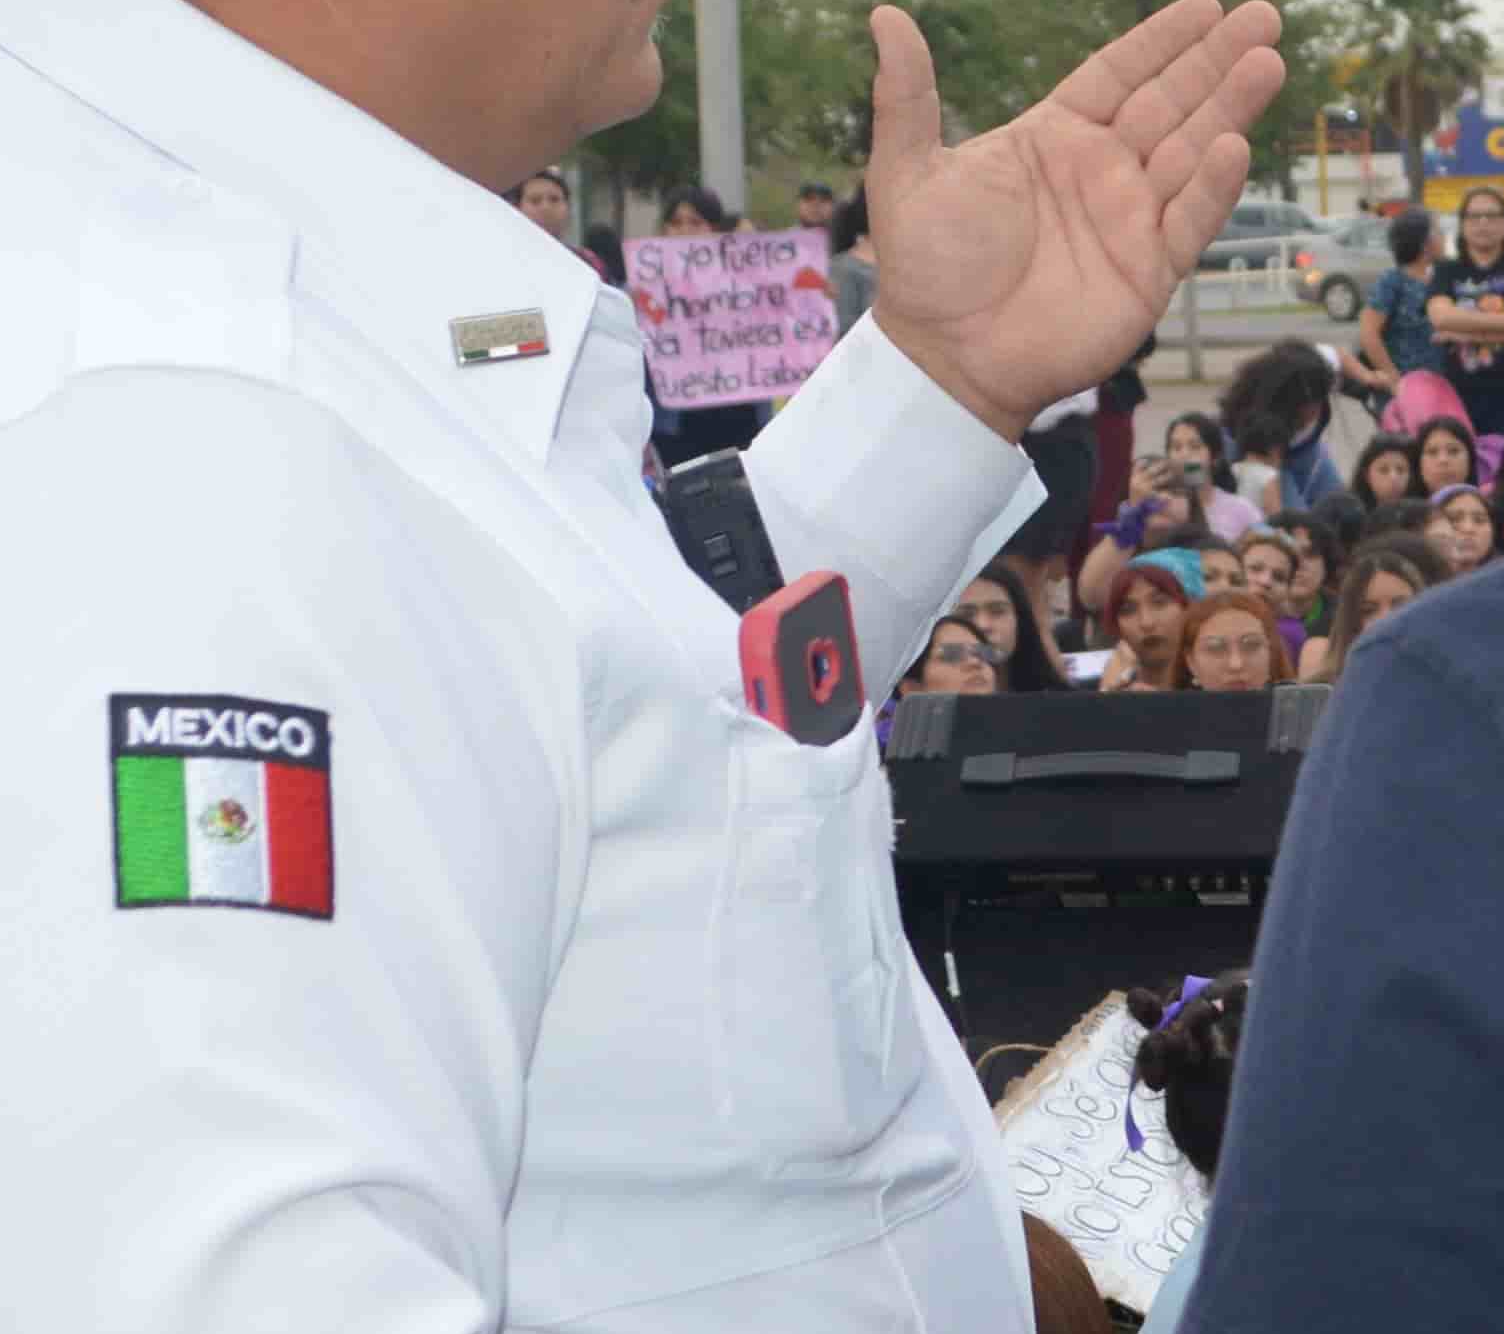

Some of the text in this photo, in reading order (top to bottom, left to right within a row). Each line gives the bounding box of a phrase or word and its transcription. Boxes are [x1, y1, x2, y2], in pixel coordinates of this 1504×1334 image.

[719, 235, 798, 272] fuera
[665, 278, 786, 317] hombre
[126, 707, 315, 757] MEXICO
